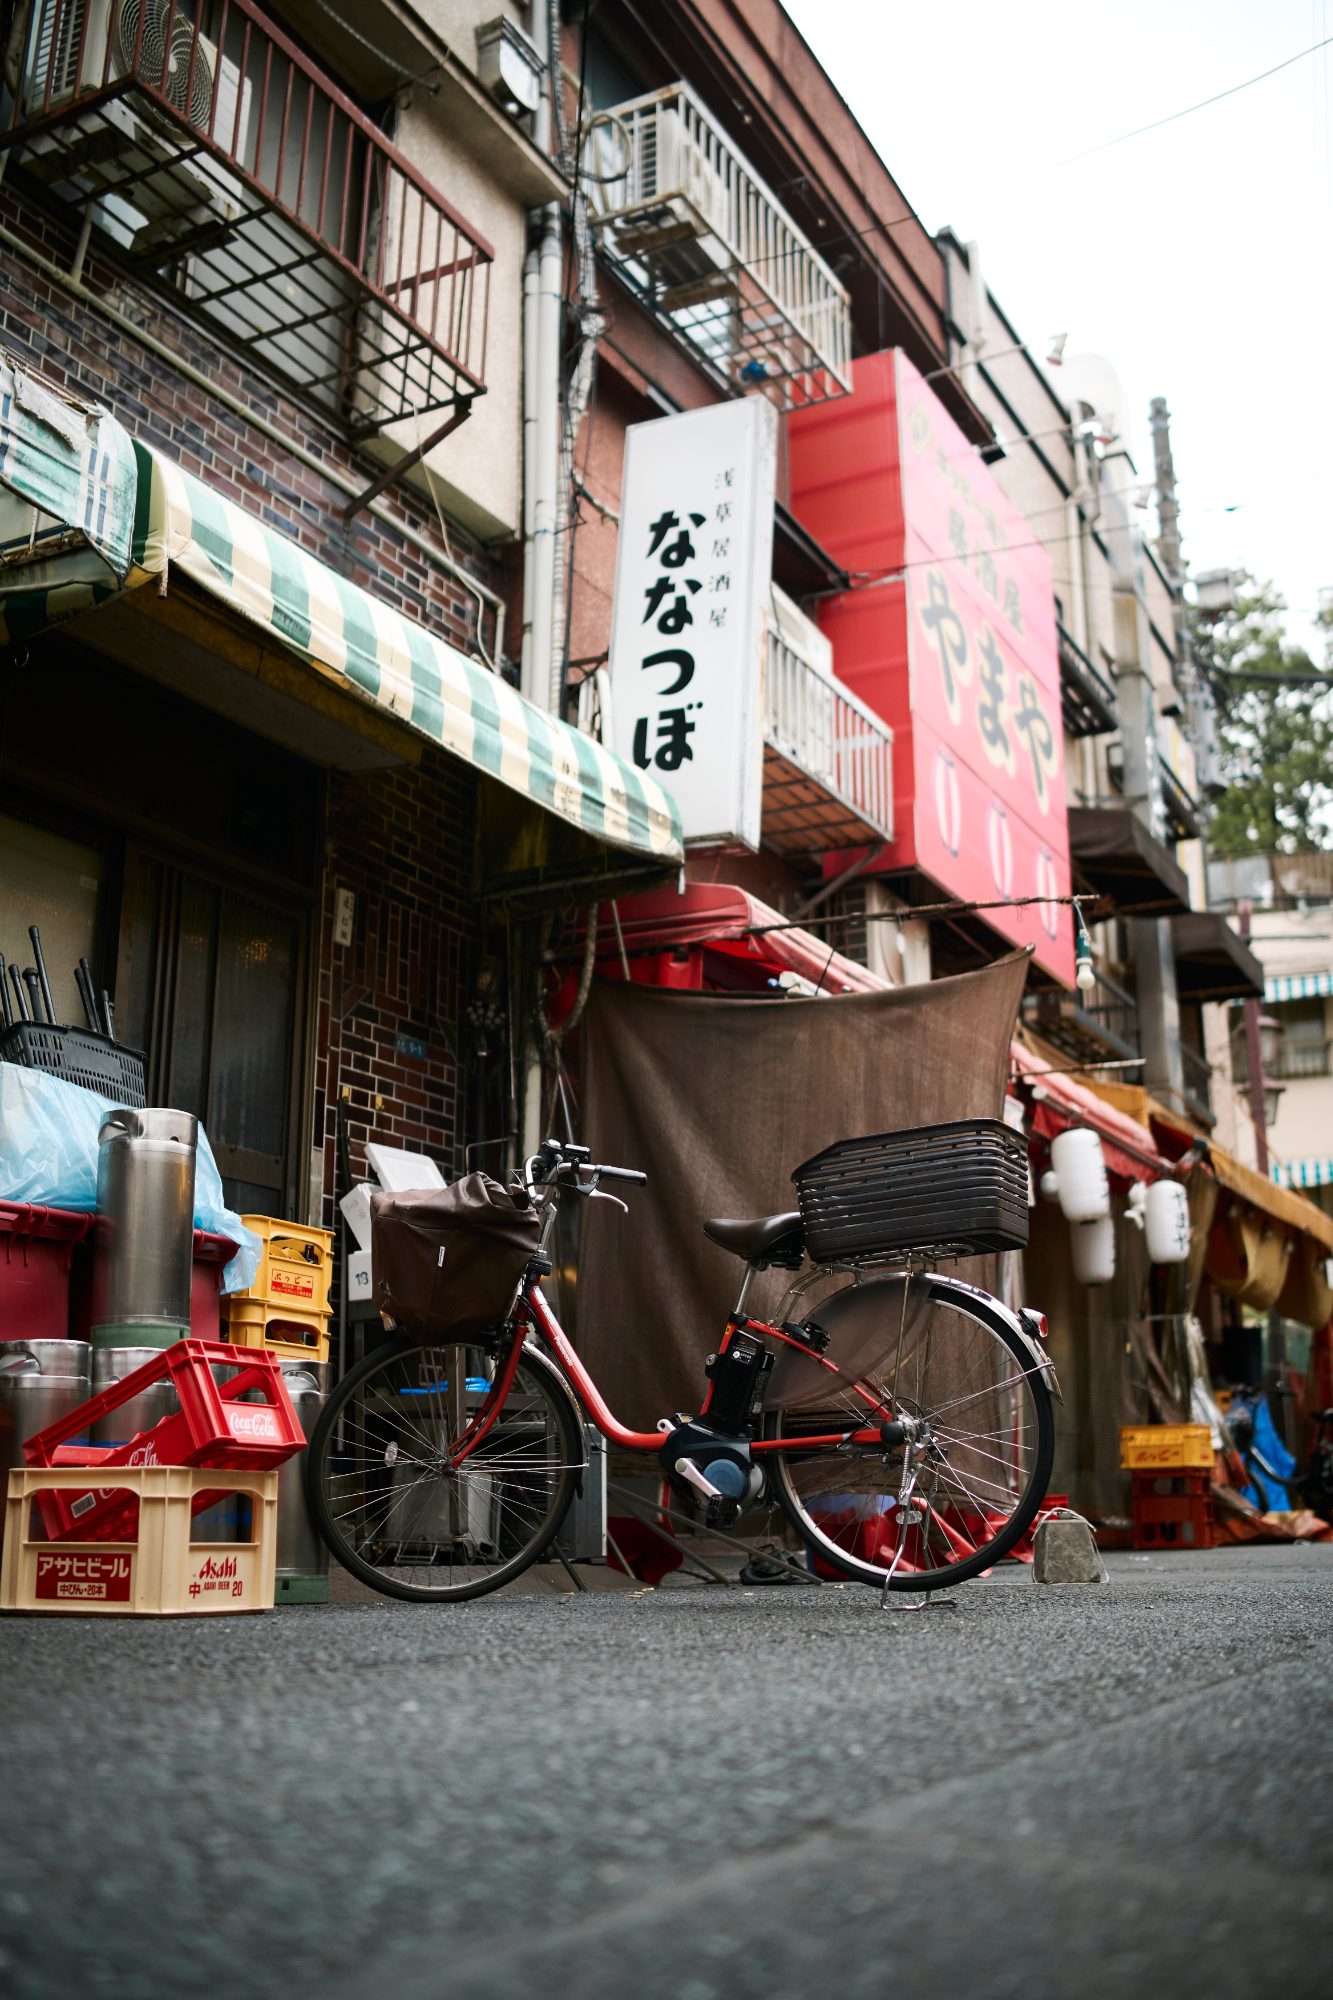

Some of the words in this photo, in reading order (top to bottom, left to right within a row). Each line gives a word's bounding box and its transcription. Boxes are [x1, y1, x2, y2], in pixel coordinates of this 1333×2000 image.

[707, 466, 736, 629] 浅草居酒屋
[632, 508, 706, 773] ななつぼ
[918, 564, 1057, 808] やまや
[553, 1334, 574, 1367] Panasonic
[38, 1556, 130, 1578] アサヒビール
[199, 1555, 237, 1580] Asahi
[60, 1583, 104, 1596] 中びん・20本
[189, 1581, 201, 1599] 中
[218, 1581, 230, 1590] BEER
[232, 1580, 243, 1597] 20
